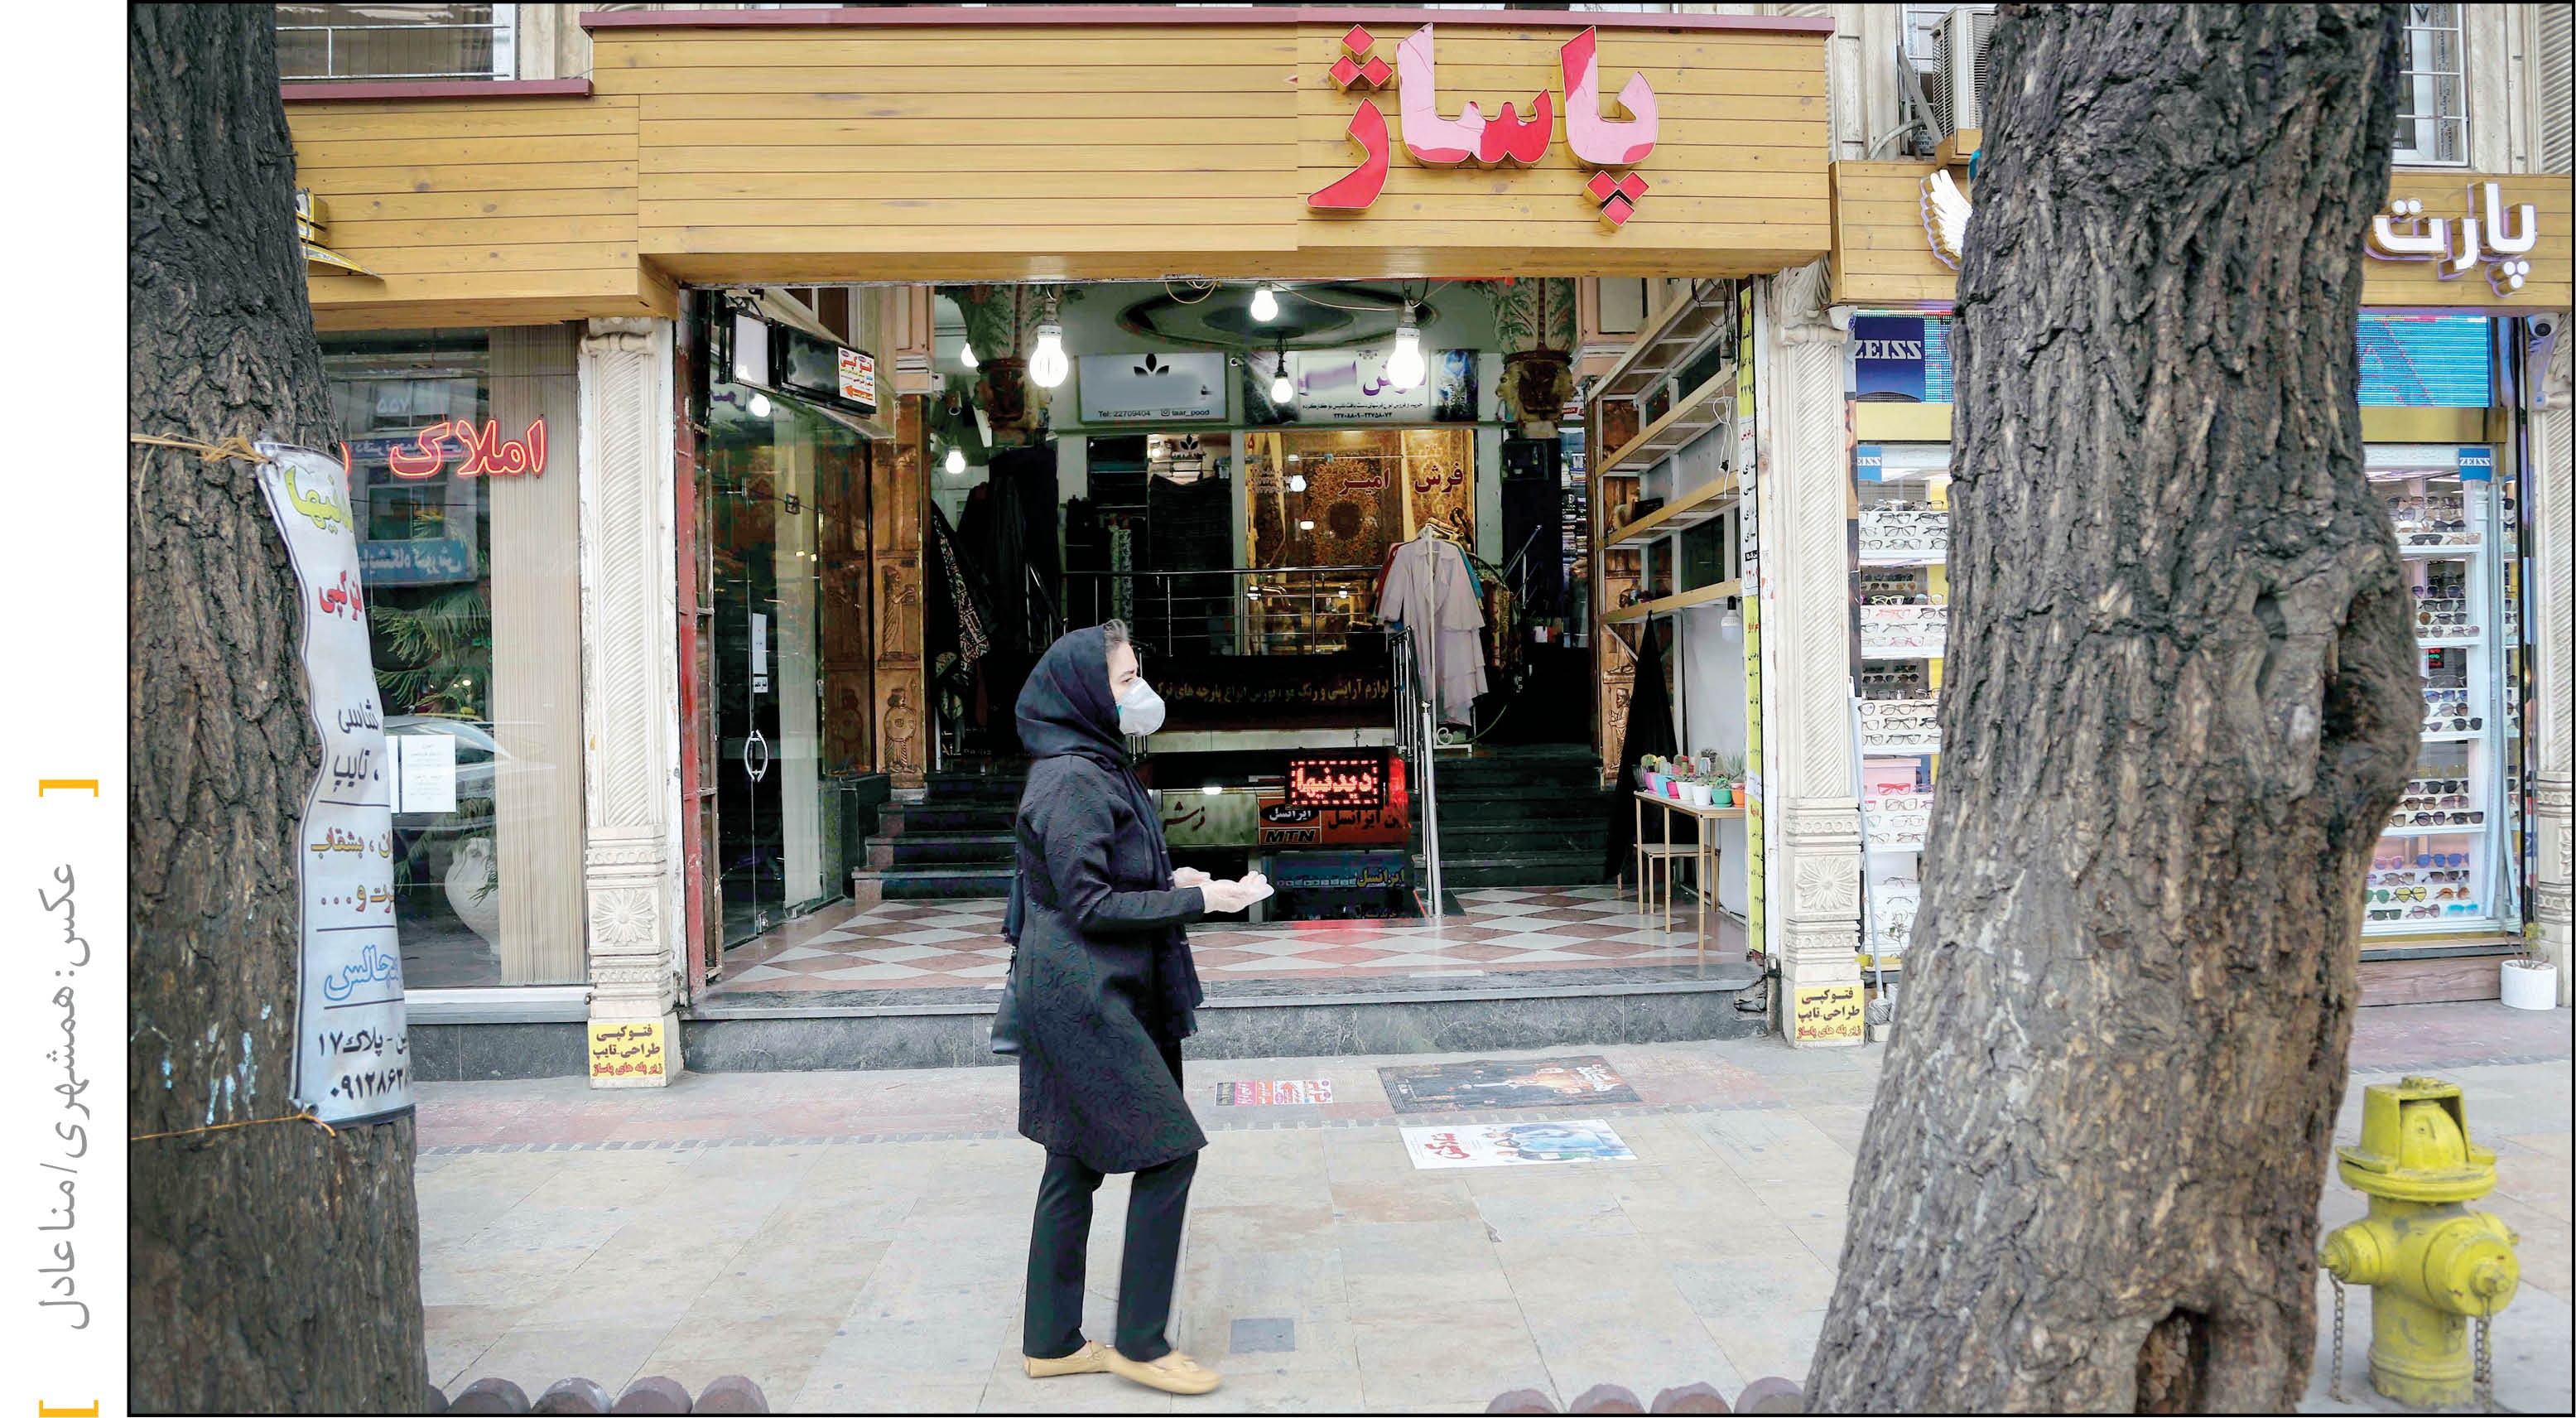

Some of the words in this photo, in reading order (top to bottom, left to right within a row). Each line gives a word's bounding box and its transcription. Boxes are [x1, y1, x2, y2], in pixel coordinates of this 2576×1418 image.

[1306, 22, 1659, 231] پاساژ
[2368, 181, 2537, 296] پارت
[1855, 340, 1922, 359] ZEISS
[388, 418, 549, 478] املاک
[1857, 456, 1882, 466] EISS
[2458, 456, 2491, 467] ZEISS
[1338, 467, 1390, 495] امیر
[1414, 461, 1465, 494] فرش
[1327, 678, 1362, 702] آرایشی
[1365, 678, 1390, 700] لوازم
[1269, 806, 1312, 822] ایرانسل
[311, 827, 364, 860] بشقاب
[1264, 829, 1316, 843] MTN
